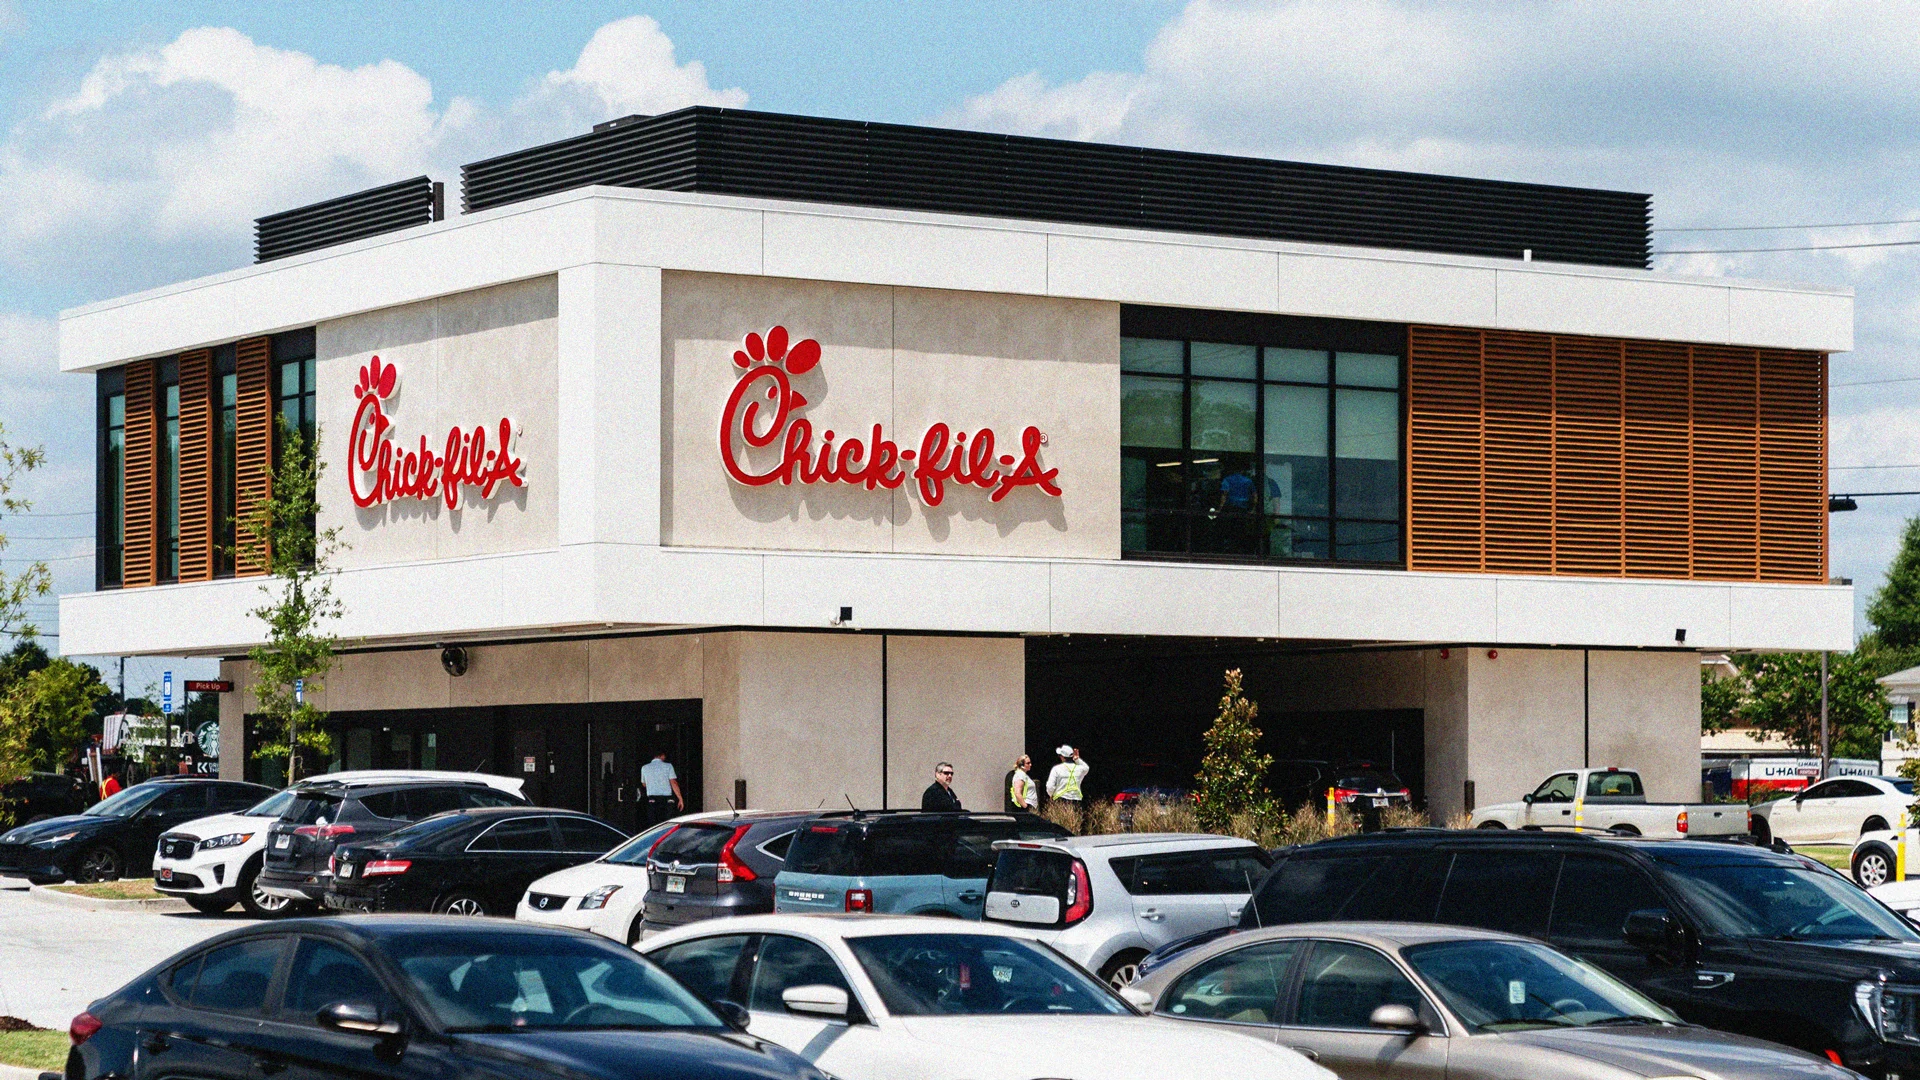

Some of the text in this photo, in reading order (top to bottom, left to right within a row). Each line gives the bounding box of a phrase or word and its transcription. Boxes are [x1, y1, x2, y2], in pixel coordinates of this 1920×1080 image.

[347, 355, 526, 510] Chick-fil-A
[719, 326, 1063, 507] Chick-fil-A
[195, 682, 221, 691] Pick Up
